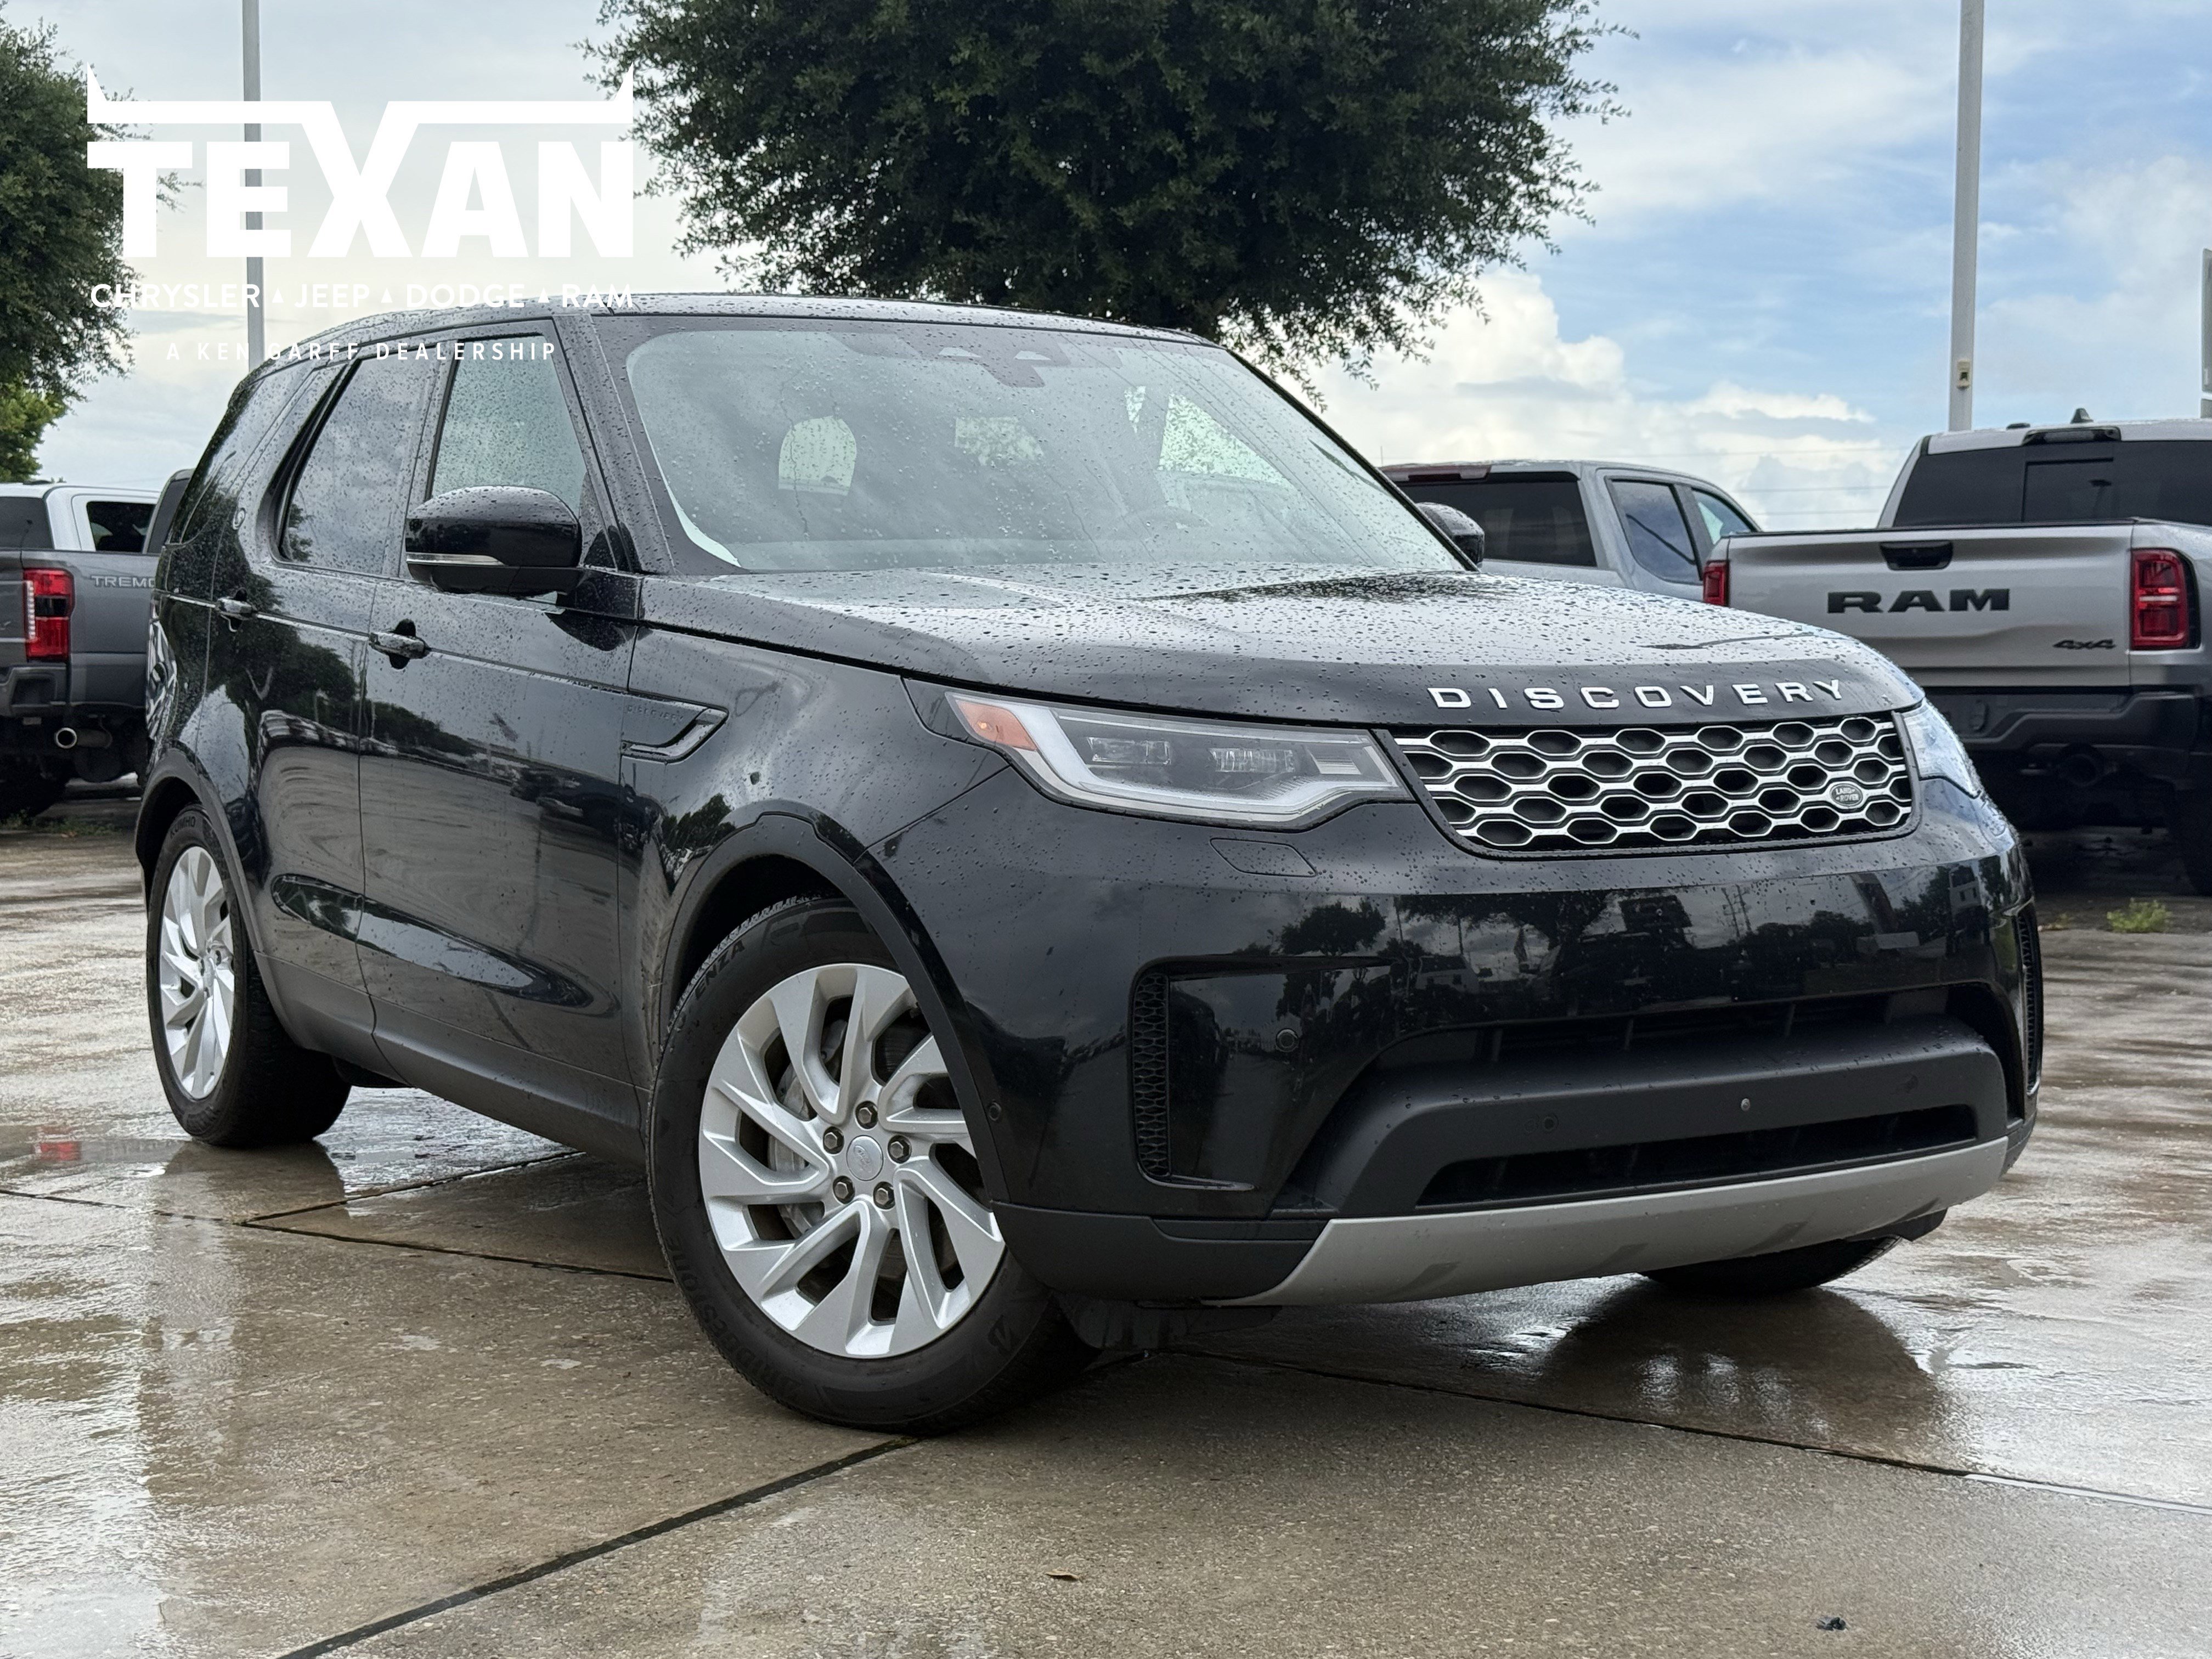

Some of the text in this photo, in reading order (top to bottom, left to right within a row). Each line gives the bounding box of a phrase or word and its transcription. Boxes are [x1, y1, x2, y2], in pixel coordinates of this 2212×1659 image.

[1827, 589, 2010, 613] RAM
[2053, 639, 2116, 650] 4x4
[1427, 679, 1842, 709] DISCOVERY
